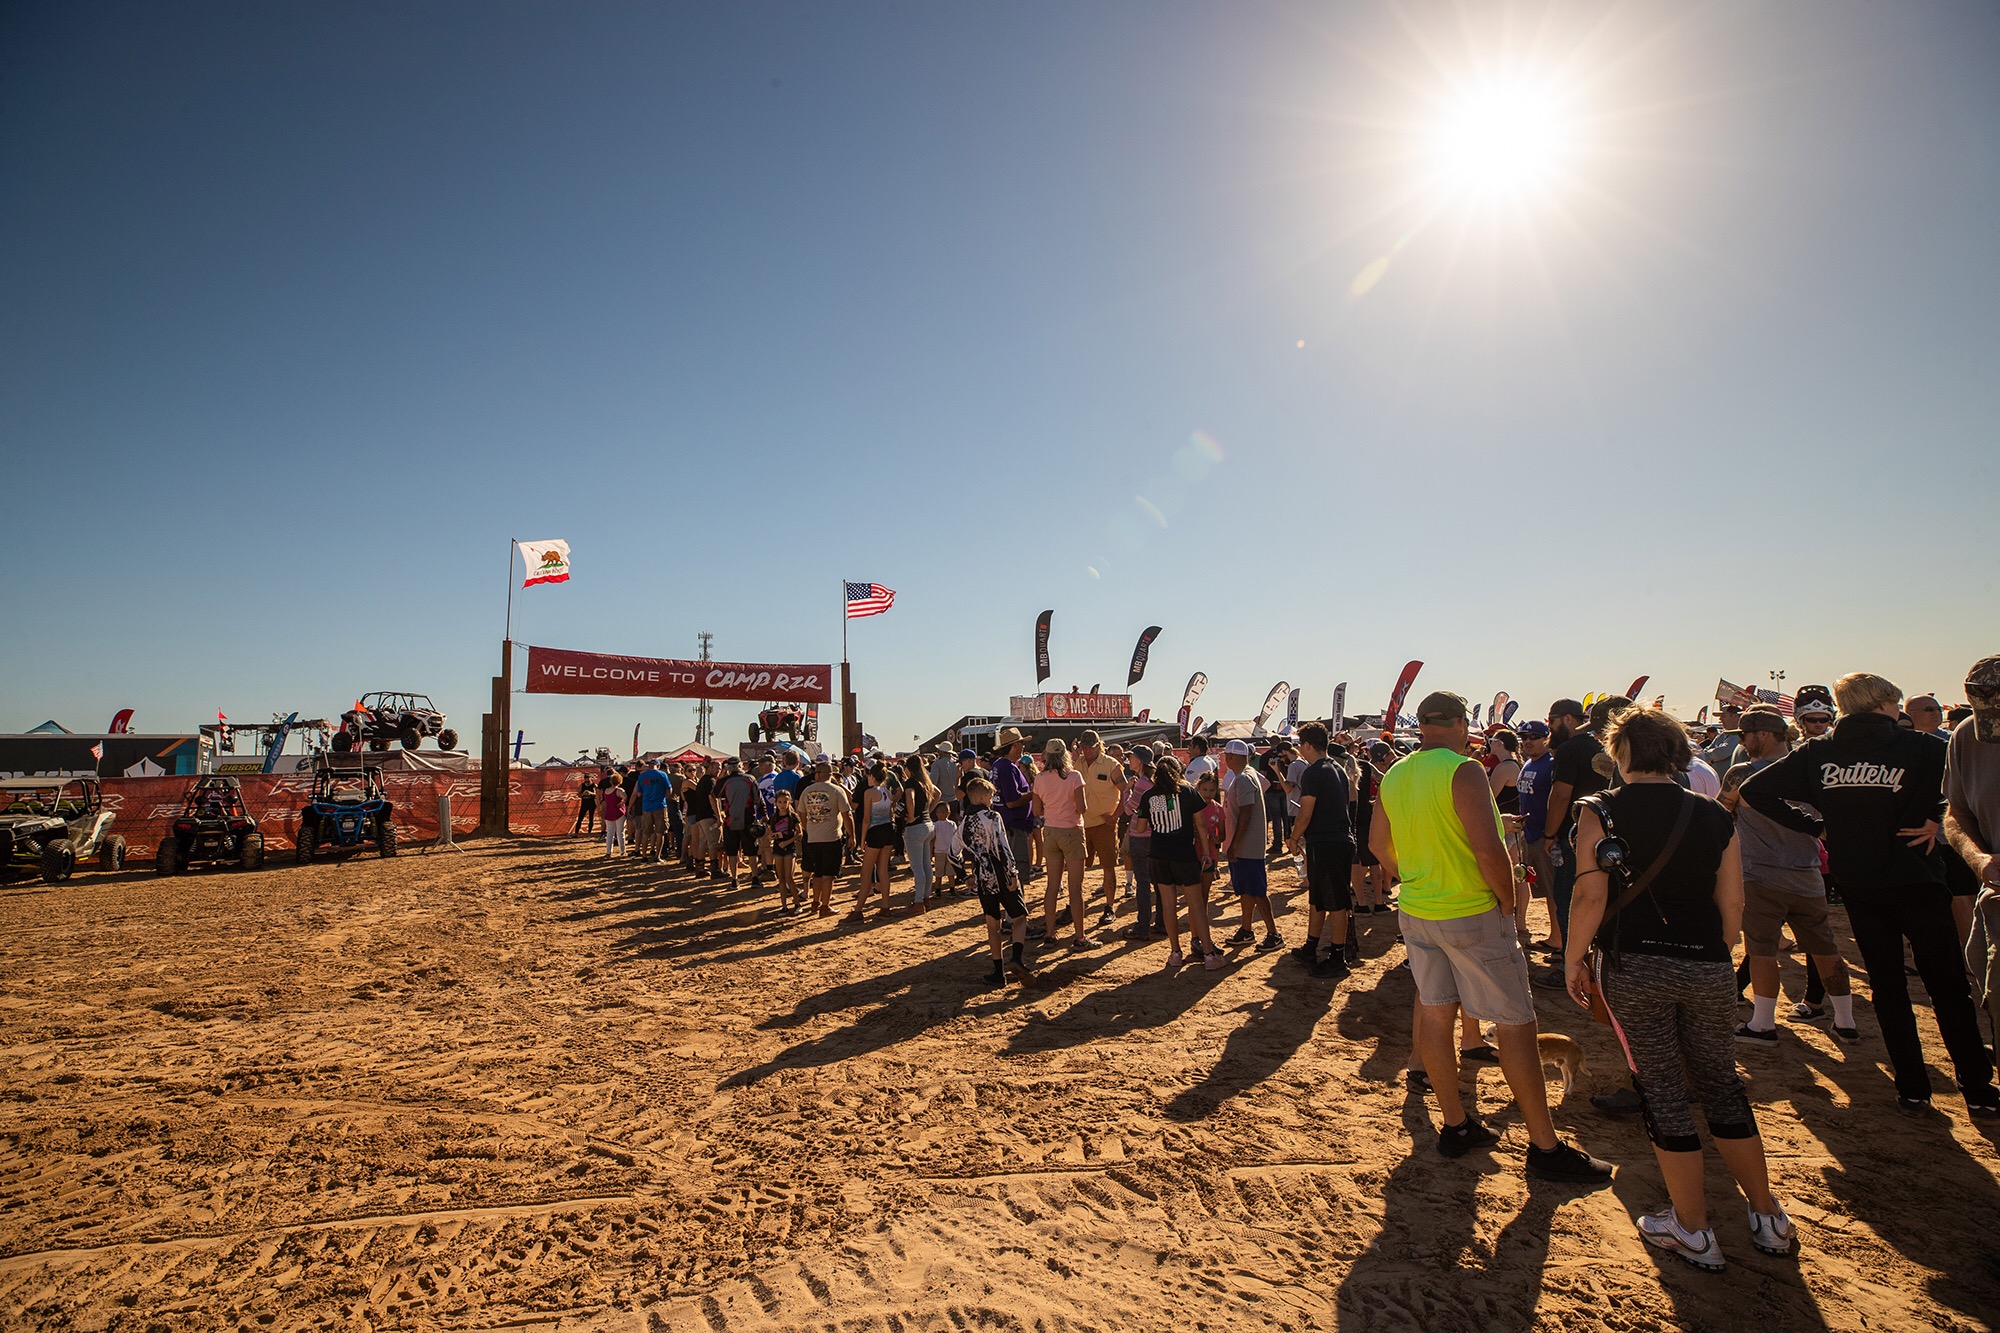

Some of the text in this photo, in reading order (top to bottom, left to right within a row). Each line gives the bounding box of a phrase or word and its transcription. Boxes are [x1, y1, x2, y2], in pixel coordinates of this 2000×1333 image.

[541, 664, 823, 692] WELCOME TO CAMP RZR
[1820, 761, 1906, 793] Buttery
